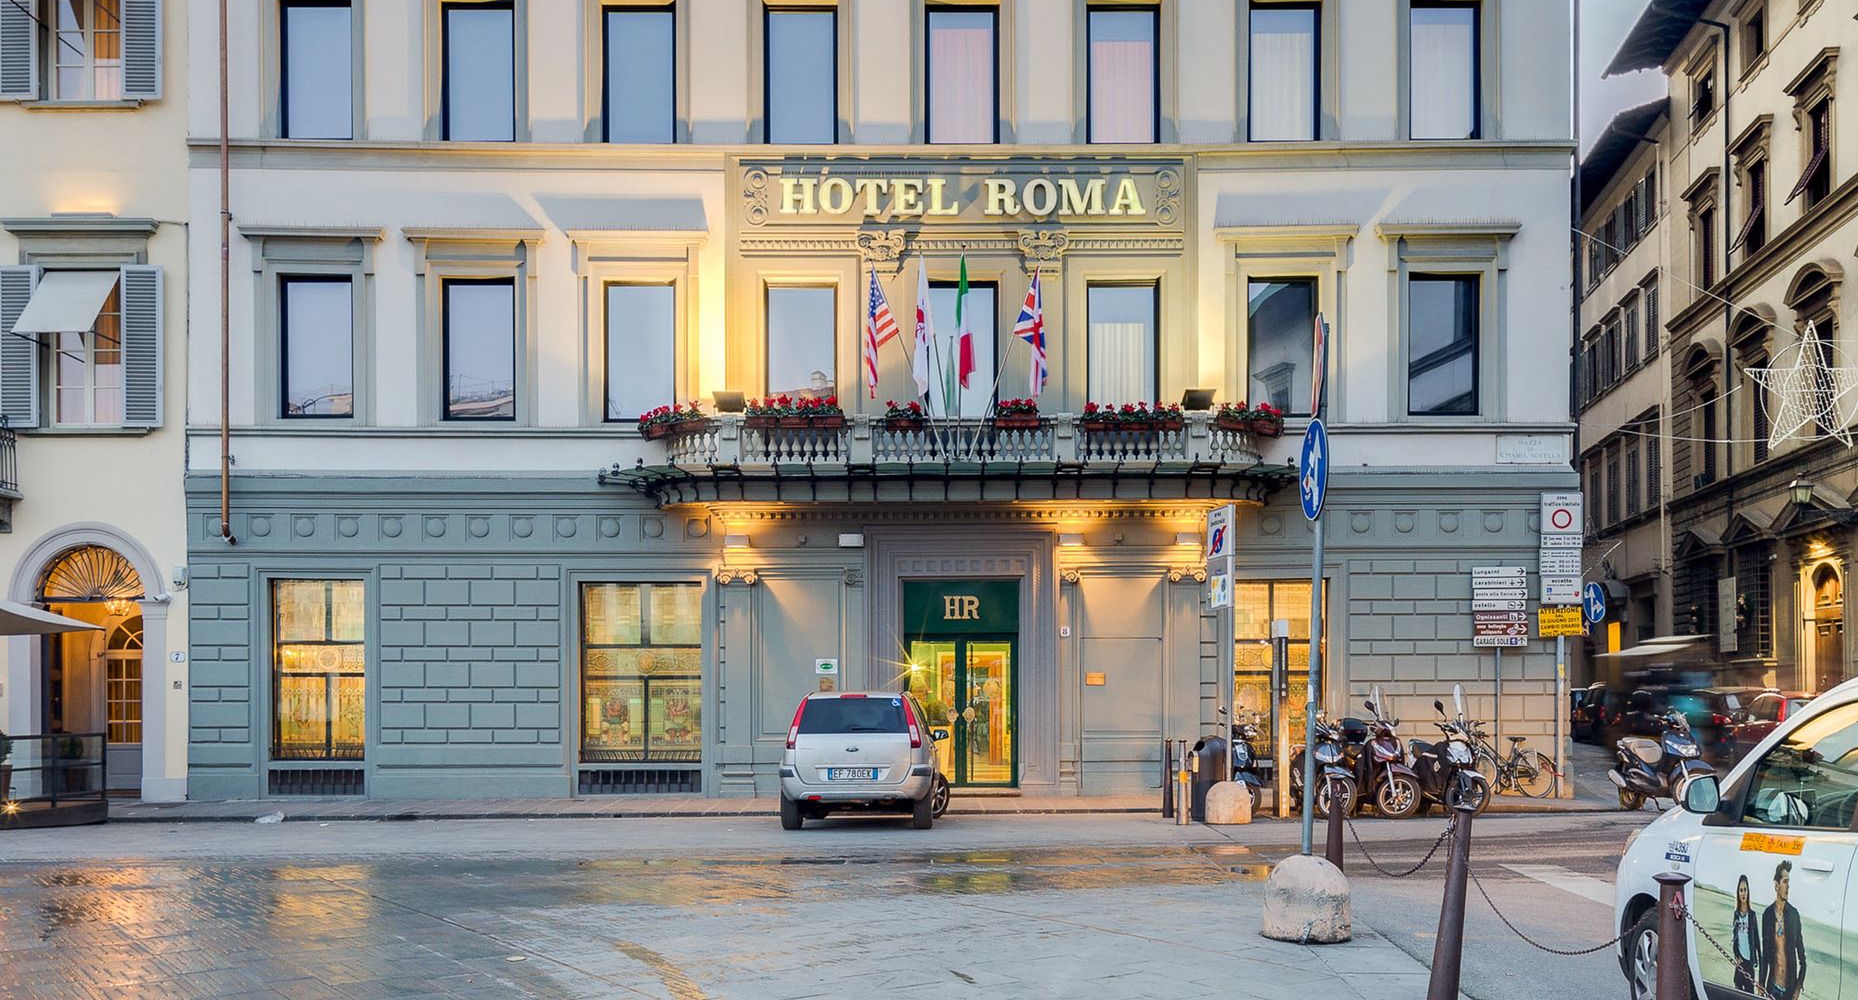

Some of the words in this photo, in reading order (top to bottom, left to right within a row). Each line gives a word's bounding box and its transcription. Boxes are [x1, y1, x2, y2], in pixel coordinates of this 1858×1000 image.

[778, 177, 959, 216] HOTEL
[984, 178, 1147, 216] ROMA
[943, 596, 980, 620] HR
[1497, 637, 1509, 645] SOLE
[833, 768, 844, 778] EF
